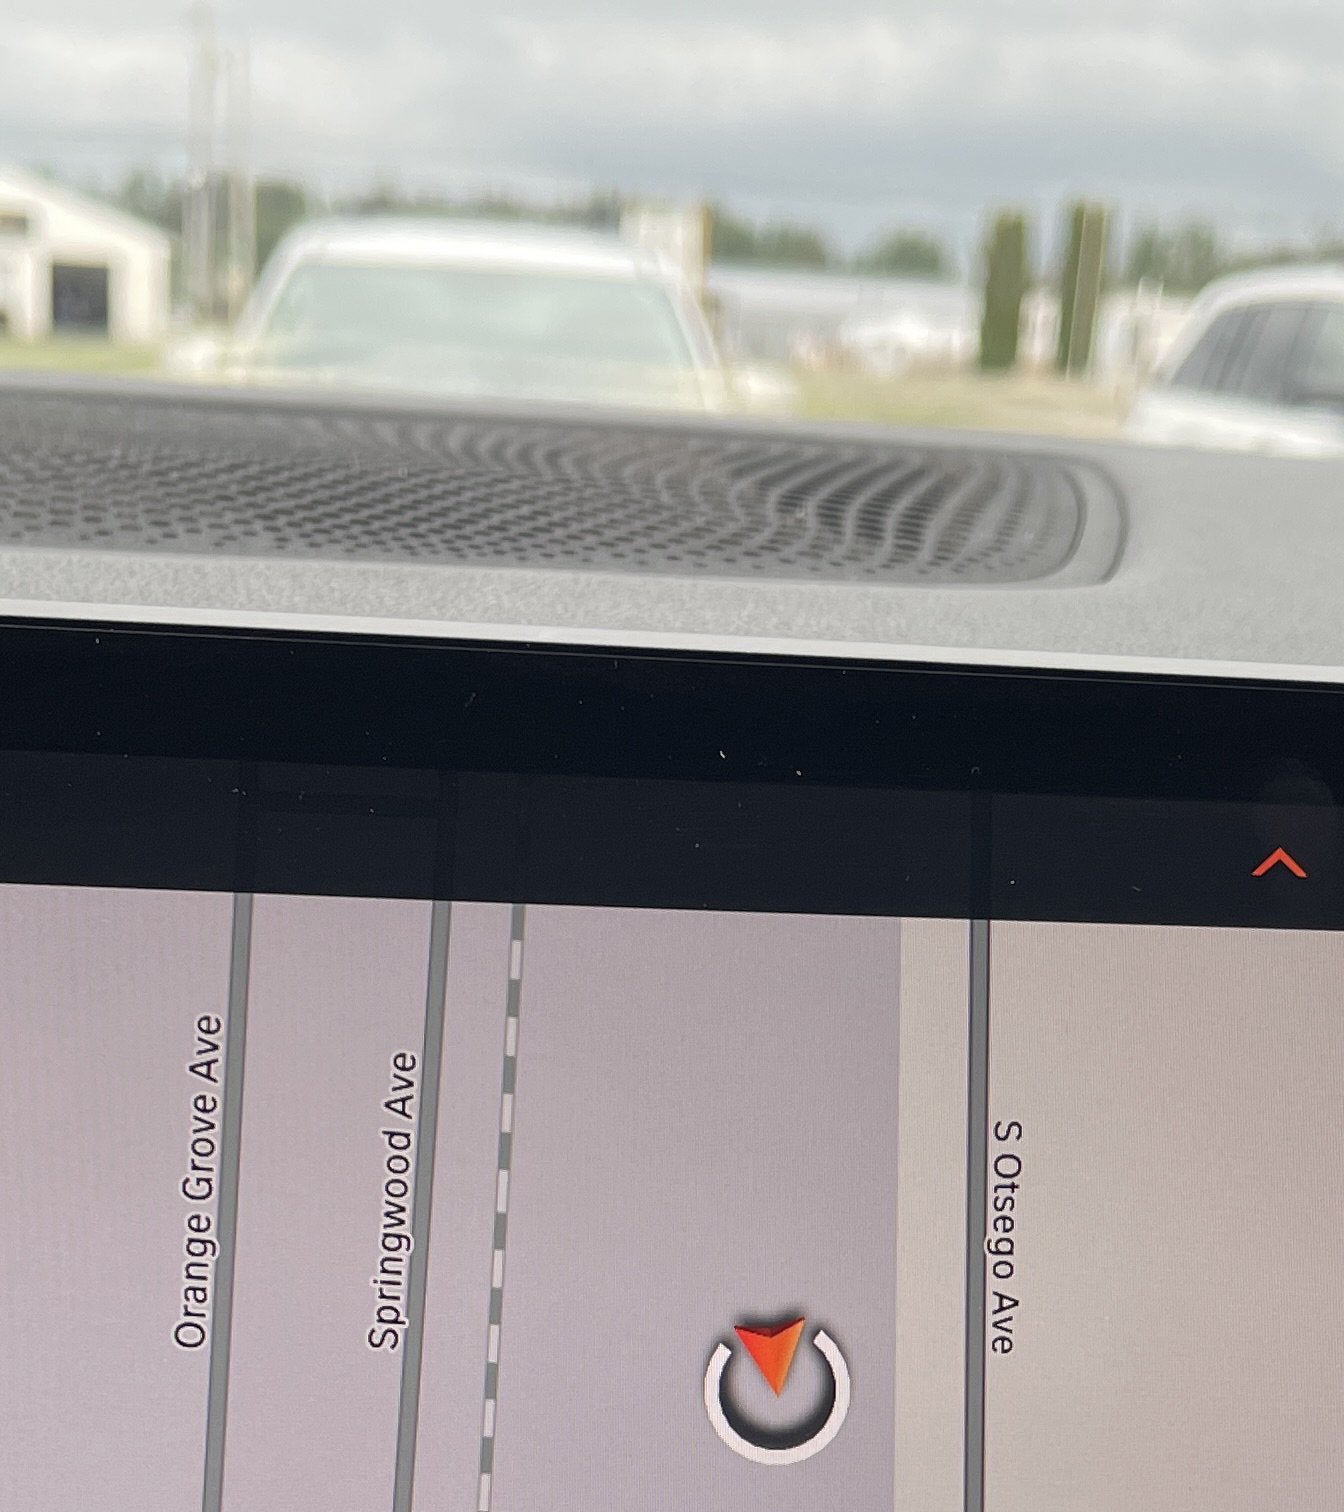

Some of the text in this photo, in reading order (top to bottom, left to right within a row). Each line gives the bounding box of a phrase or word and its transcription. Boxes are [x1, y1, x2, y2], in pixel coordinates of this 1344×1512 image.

[175, 1014, 221, 1349] Orange Grove Ave
[368, 1051, 417, 1351] Springwood Ave
[986, 1120, 1023, 1355] S Otsego Ave
